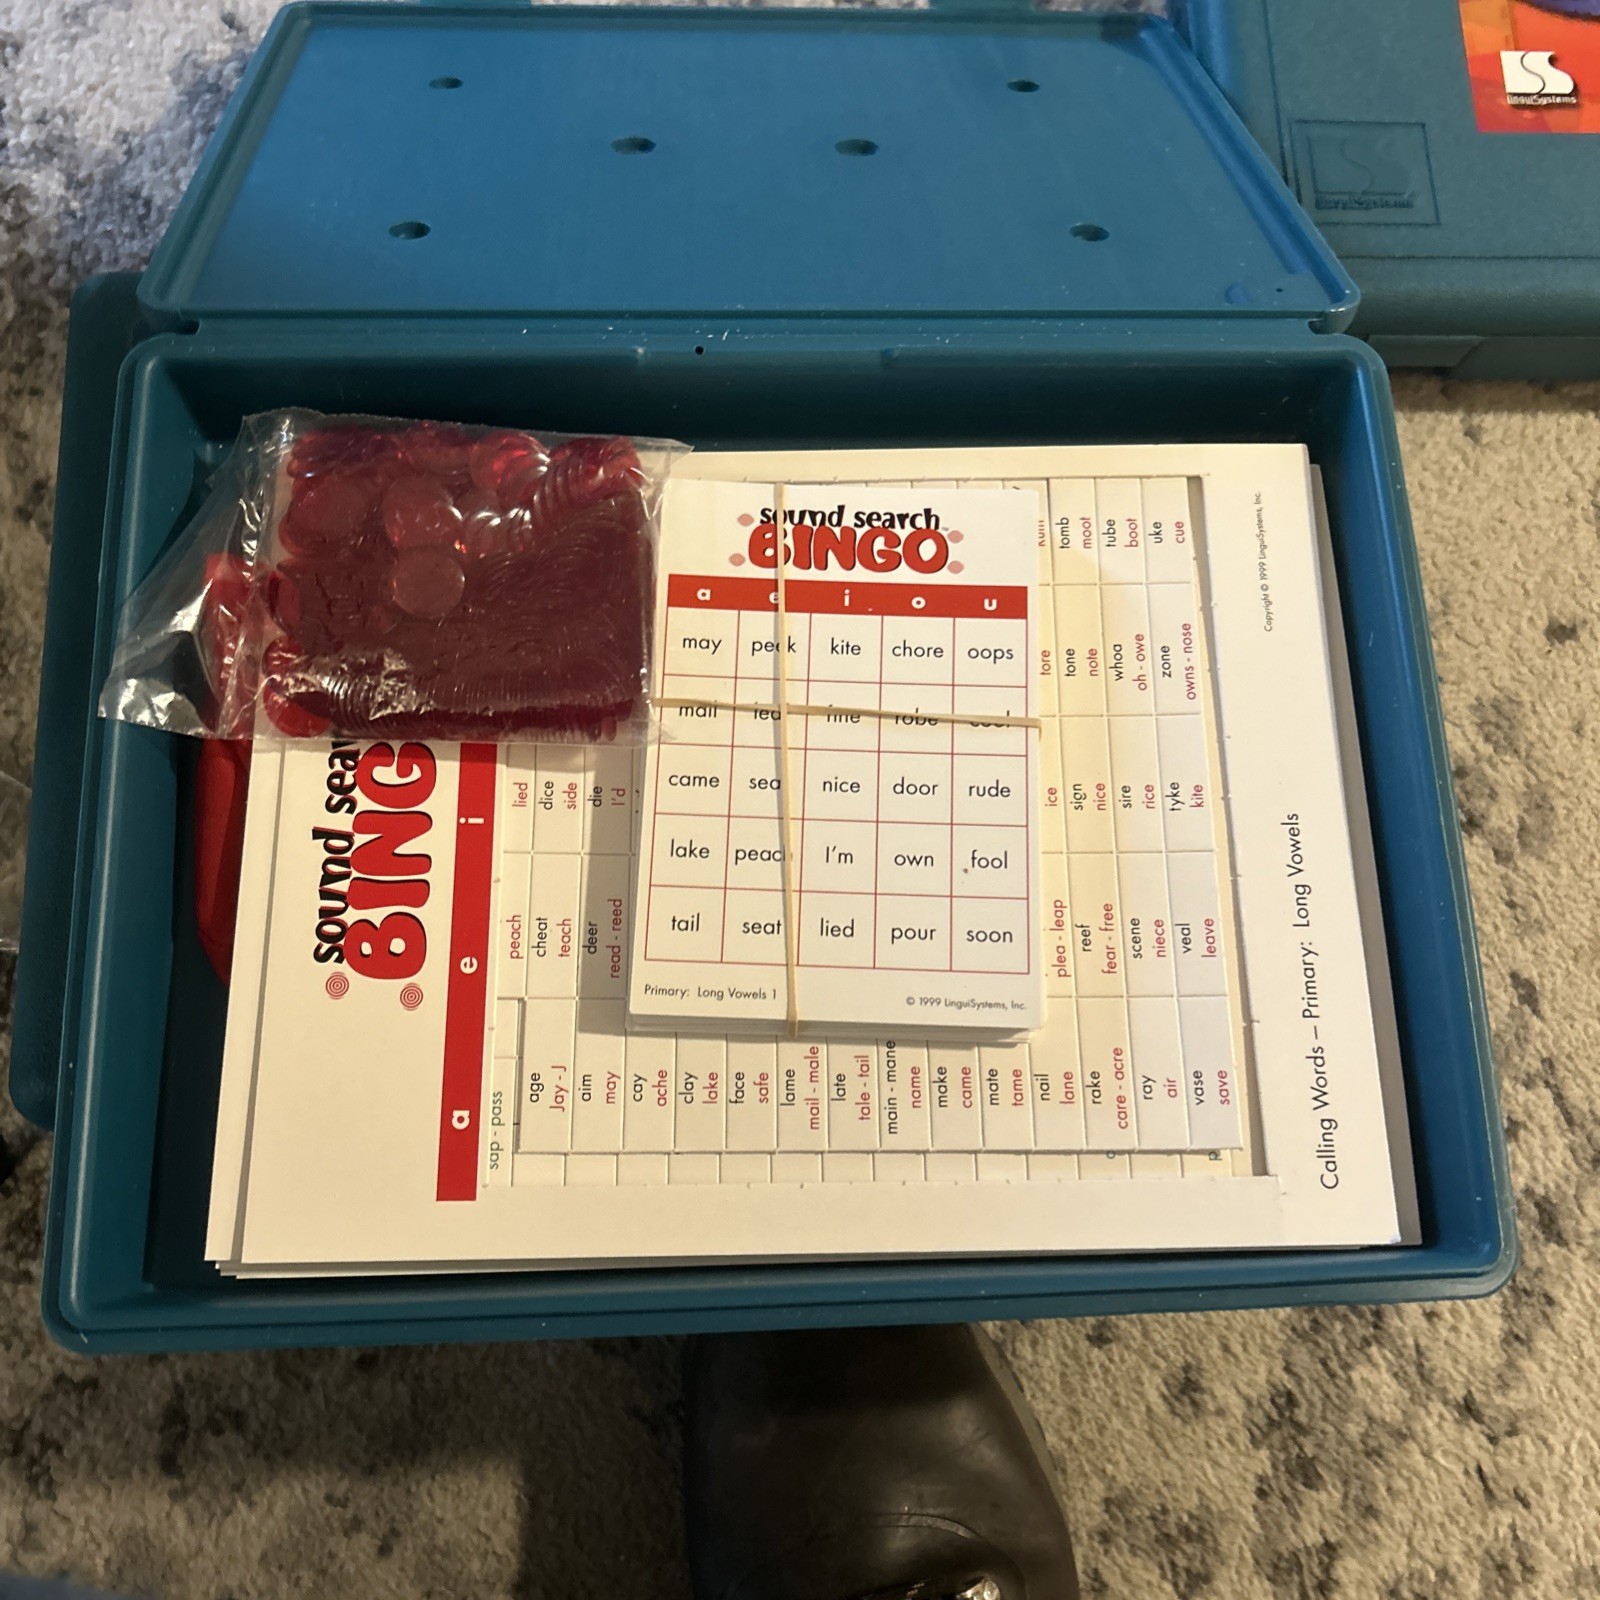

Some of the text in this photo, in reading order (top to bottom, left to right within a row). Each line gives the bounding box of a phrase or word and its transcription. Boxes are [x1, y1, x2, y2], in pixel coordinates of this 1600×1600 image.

[759, 505, 940, 531] sound search
[1175, 521, 1185, 543] cue
[1055, 517, 1070, 549] tomb
[1080, 517, 1092, 549] moot
[1102, 519, 1116, 547] tube
[1124, 518, 1138, 547] boot
[1148, 522, 1163, 543] uke
[748, 523, 949, 574] BINGO
[1258, 562, 1267, 580] 1999
[697, 588, 711, 601] a
[844, 590, 850, 607] i
[911, 596, 926, 609] o
[983, 597, 997, 611] u
[1261, 594, 1273, 632] Copyright
[683, 638, 722, 655] may
[831, 637, 861, 655] kite
[892, 641, 943, 658] chore
[1135, 634, 1145, 662] owe
[1182, 623, 1193, 653] nose
[968, 648, 1013, 663] oops
[1040, 650, 1051, 675] tore
[1065, 649, 1076, 677] tone
[1086, 649, 1098, 676] note
[1109, 644, 1123, 681] whoa
[1161, 646, 1171, 678] zone
[1132, 674, 1147, 691] oh
[1185, 666, 1196, 700] owns
[512, 782, 528, 807] lied
[538, 781, 554, 810] dice
[669, 775, 719, 788] came
[822, 778, 860, 793] nice
[893, 777, 938, 795] door
[969, 779, 1010, 797] rude
[562, 783, 577, 809] side
[587, 786, 602, 807] die
[611, 788, 625, 805] I'd
[1045, 787, 1057, 806] ice
[1070, 784, 1087, 810] sign
[1093, 783, 1106, 810] nice
[1118, 785, 1132, 808] sire
[1142, 785, 1155, 809] rice
[1165, 782, 1185, 811] tyke
[1189, 785, 1204, 807] kite
[671, 839, 709, 858] lake
[826, 846, 853, 864] I'm
[970, 850, 1008, 869] fool
[1281, 814, 1304, 877] Vowels
[344, 742, 437, 980] BING
[894, 855, 933, 866] own
[311, 827, 355, 964] sound
[1289, 884, 1312, 927] Long
[608, 899, 622, 931] reed
[672, 913, 699, 931] tail
[743, 920, 781, 935] seat
[821, 918, 854, 937] lied
[1049, 900, 1067, 931] leap
[1099, 904, 1114, 931] free
[506, 915, 523, 959] peach
[531, 917, 547, 957] cheat
[556, 919, 571, 957] teach
[582, 921, 597, 954] deer
[891, 925, 936, 944] pour
[967, 930, 1012, 942] soon
[1075, 924, 1091, 952] reef
[1131, 918, 1142, 959] scene
[1152, 919, 1166, 957] niece
[1175, 924, 1191, 953] veal
[1201, 919, 1216, 957] leave
[460, 957, 478, 973] e
[606, 945, 621, 978] read
[1051, 945, 1071, 977] plea
[1102, 945, 1117, 974] fear
[645, 984, 689, 999] Primary:
[698, 986, 724, 1001] Long
[728, 988, 766, 999] Vowels
[1298, 942, 1323, 1019] Primary:
[920, 997, 941, 1006] 1999
[945, 998, 1008, 1010] LinguiSystems,
[1011, 1000, 1026, 1010] Inc.
[804, 1046, 819, 1083] male
[854, 1055, 870, 1077] tail
[885, 1040, 897, 1082] mane
[1113, 1048, 1124, 1080] acre
[530, 1073, 544, 1103] age
[578, 1075, 591, 1101] aim
[606, 1071, 620, 1104] may
[633, 1074, 647, 1102] cay
[652, 1070, 667, 1106] ache
[678, 1072, 698, 1104] clay
[702, 1072, 718, 1104] lake
[729, 1072, 744, 1104] face
[753, 1072, 769, 1103] safe
[780, 1069, 795, 1106] lame
[831, 1074, 846, 1101] late
[911, 1066, 921, 1108] name
[930, 1067, 948, 1110] make
[961, 1067, 973, 1108] came
[986, 1069, 999, 1105] mate
[1012, 1069, 1024, 1106] tame
[1033, 1074, 1050, 1101] nail
[1059, 1072, 1074, 1104] lane
[1083, 1071, 1101, 1107] rake
[1142, 1075, 1156, 1100] ray
[1163, 1078, 1177, 1098] air
[1193, 1070, 1204, 1105] vase
[1218, 1070, 1230, 1105] save
[1306, 1047, 1329, 1110] Words
[492, 1091, 505, 1126] pass
[549, 1085, 569, 1112] Jay
[855, 1092, 870, 1120] tale
[1116, 1095, 1128, 1129] care
[451, 1110, 471, 1130] a
[804, 1098, 819, 1129] mail
[884, 1098, 897, 1134] main
[1316, 1119, 1338, 1189] Calling
